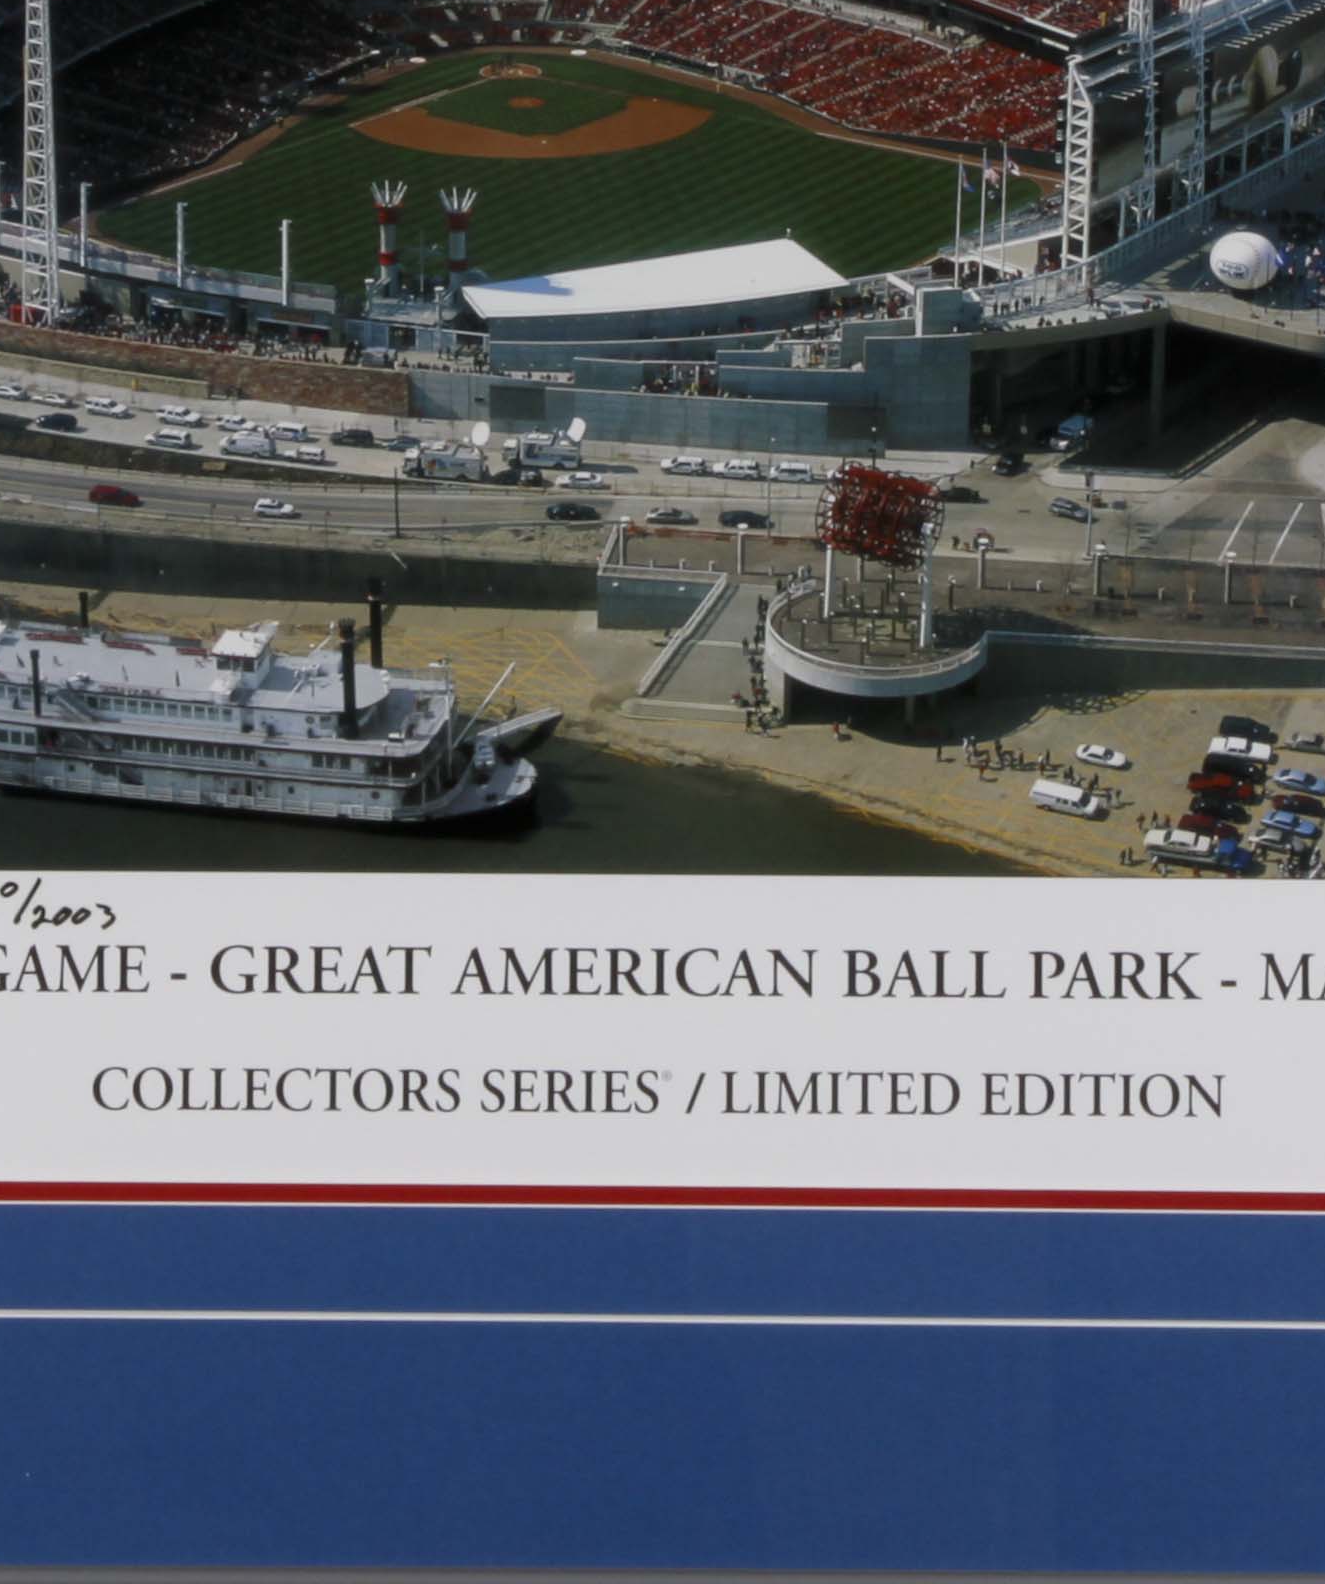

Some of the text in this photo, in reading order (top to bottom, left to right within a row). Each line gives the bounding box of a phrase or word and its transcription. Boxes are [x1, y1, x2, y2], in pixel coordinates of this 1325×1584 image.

[210, 944, 433, 995] GREAT
[451, 947, 817, 998] AMERICAN
[843, 949, 1007, 999] BALL
[1029, 951, 1201, 1000] PARK
[92, 1066, 461, 1113] COLLECTORS
[722, 1071, 961, 1116] LIMITED
[981, 1073, 1224, 1118] EDITION
